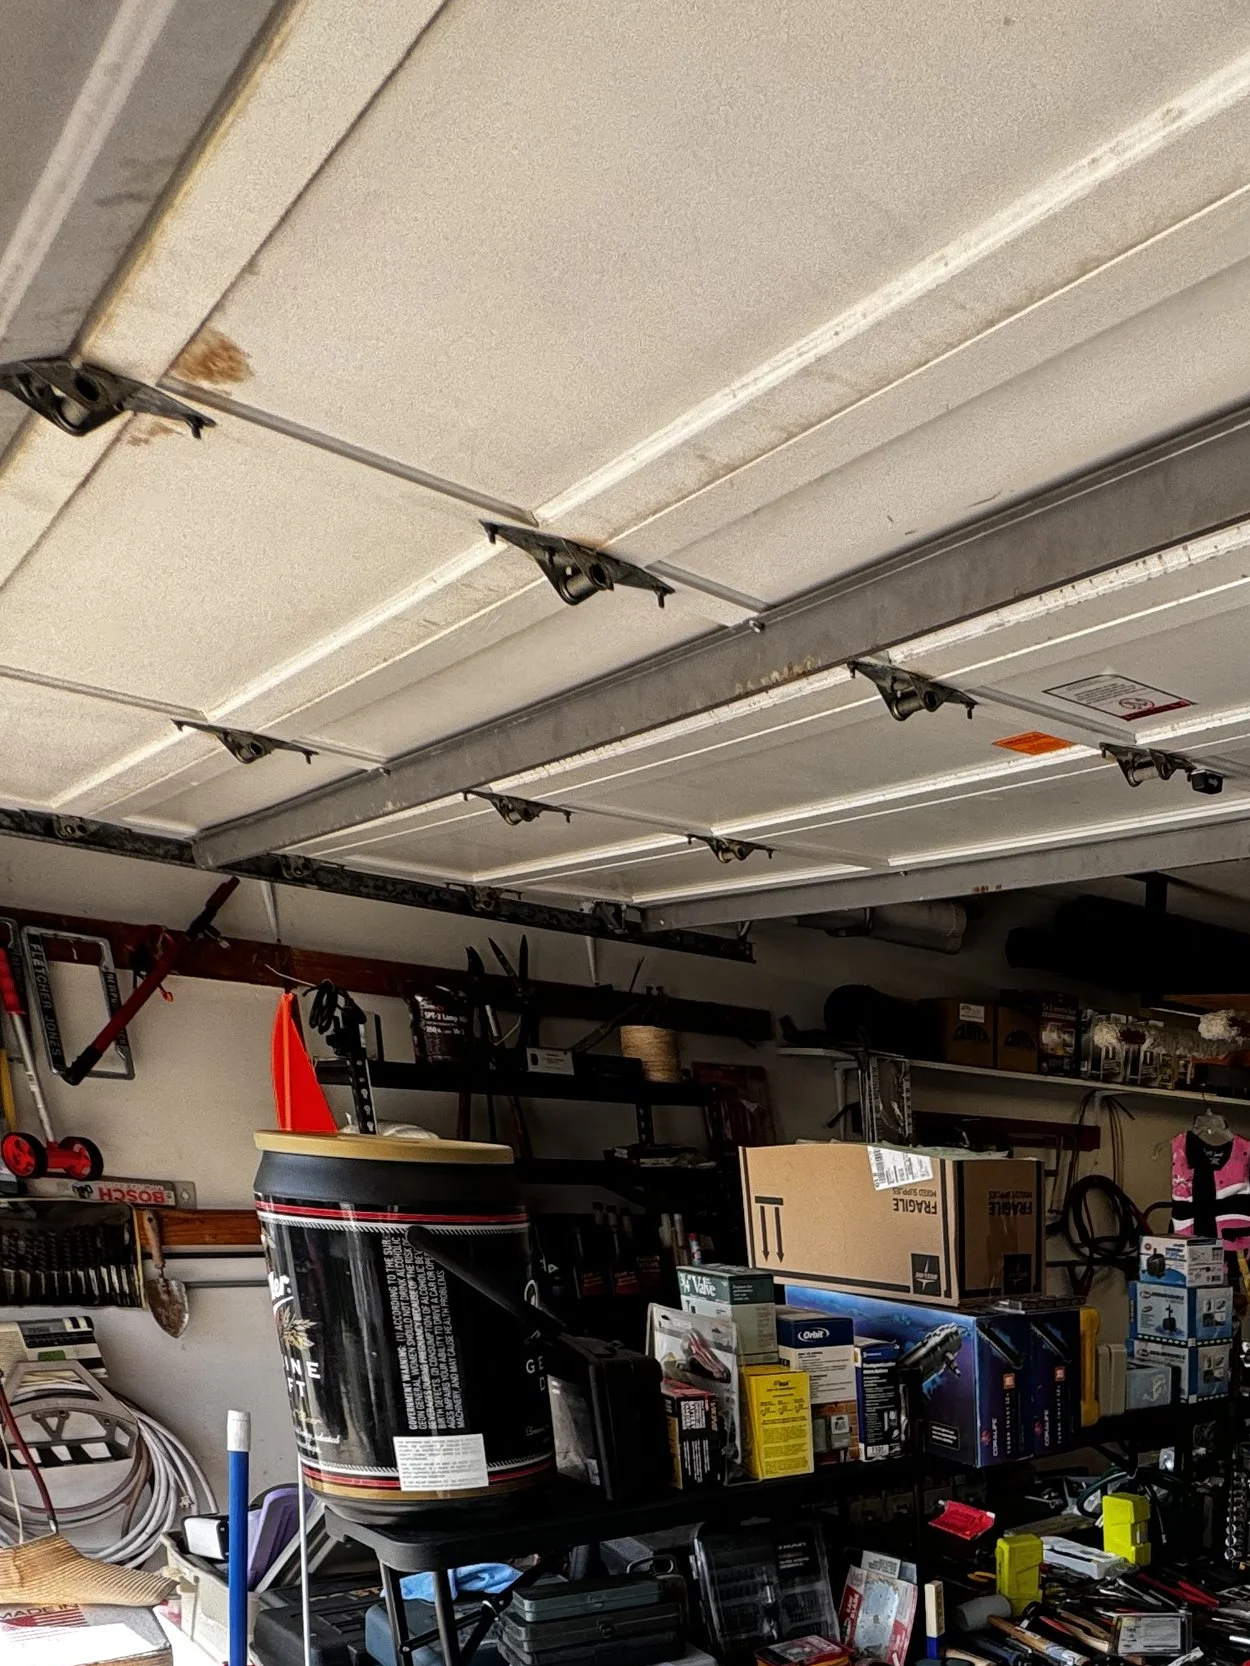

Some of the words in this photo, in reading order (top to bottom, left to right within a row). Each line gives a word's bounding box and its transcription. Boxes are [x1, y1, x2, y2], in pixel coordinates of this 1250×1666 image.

[29, 943, 52, 1013] FLETCHER
[43, 1016, 61, 1058] JONES
[99, 1187, 165, 1204] BOSCH
[892, 1198, 937, 1215] FRAGILE
[988, 1201, 1033, 1216] FRAGILE
[384, 1256, 394, 1272] THE
[391, 1237, 406, 1277] ALCOHOLIC
[413, 1250, 424, 1265] BEV
[387, 1274, 397, 1284] TO
[405, 1264, 416, 1279] THE
[426, 1271, 436, 1281] OR
[397, 1278, 409, 1300] DRINK
[415, 1265, 430, 1304] ALCOHOLIC
[428, 1282, 438, 1297] CAR
[436, 1270, 449, 1307] PROBLEMS
[388, 1286, 403, 1331] ACCORDING
[400, 1301, 411, 1317] NOT
[421, 1305, 431, 1314] OF
[431, 1304, 442, 1325] DRIVE
[441, 1308, 453, 1334] HEALTH
[403, 1317, 416, 1346] SHOULD
[434, 1325, 443, 1335] TO
[802, 1330, 825, 1340] Orbit
[444, 1335, 456, 1357] CAUSE
[408, 1347, 420, 1376] WOMEN
[447, 1357, 458, 1373] MAY
[439, 1363, 449, 1382] YOUR
[450, 1373, 460, 1388] AND
[416, 1410, 428, 1430] GEON
[435, 1409, 447, 1429] BIRTH
